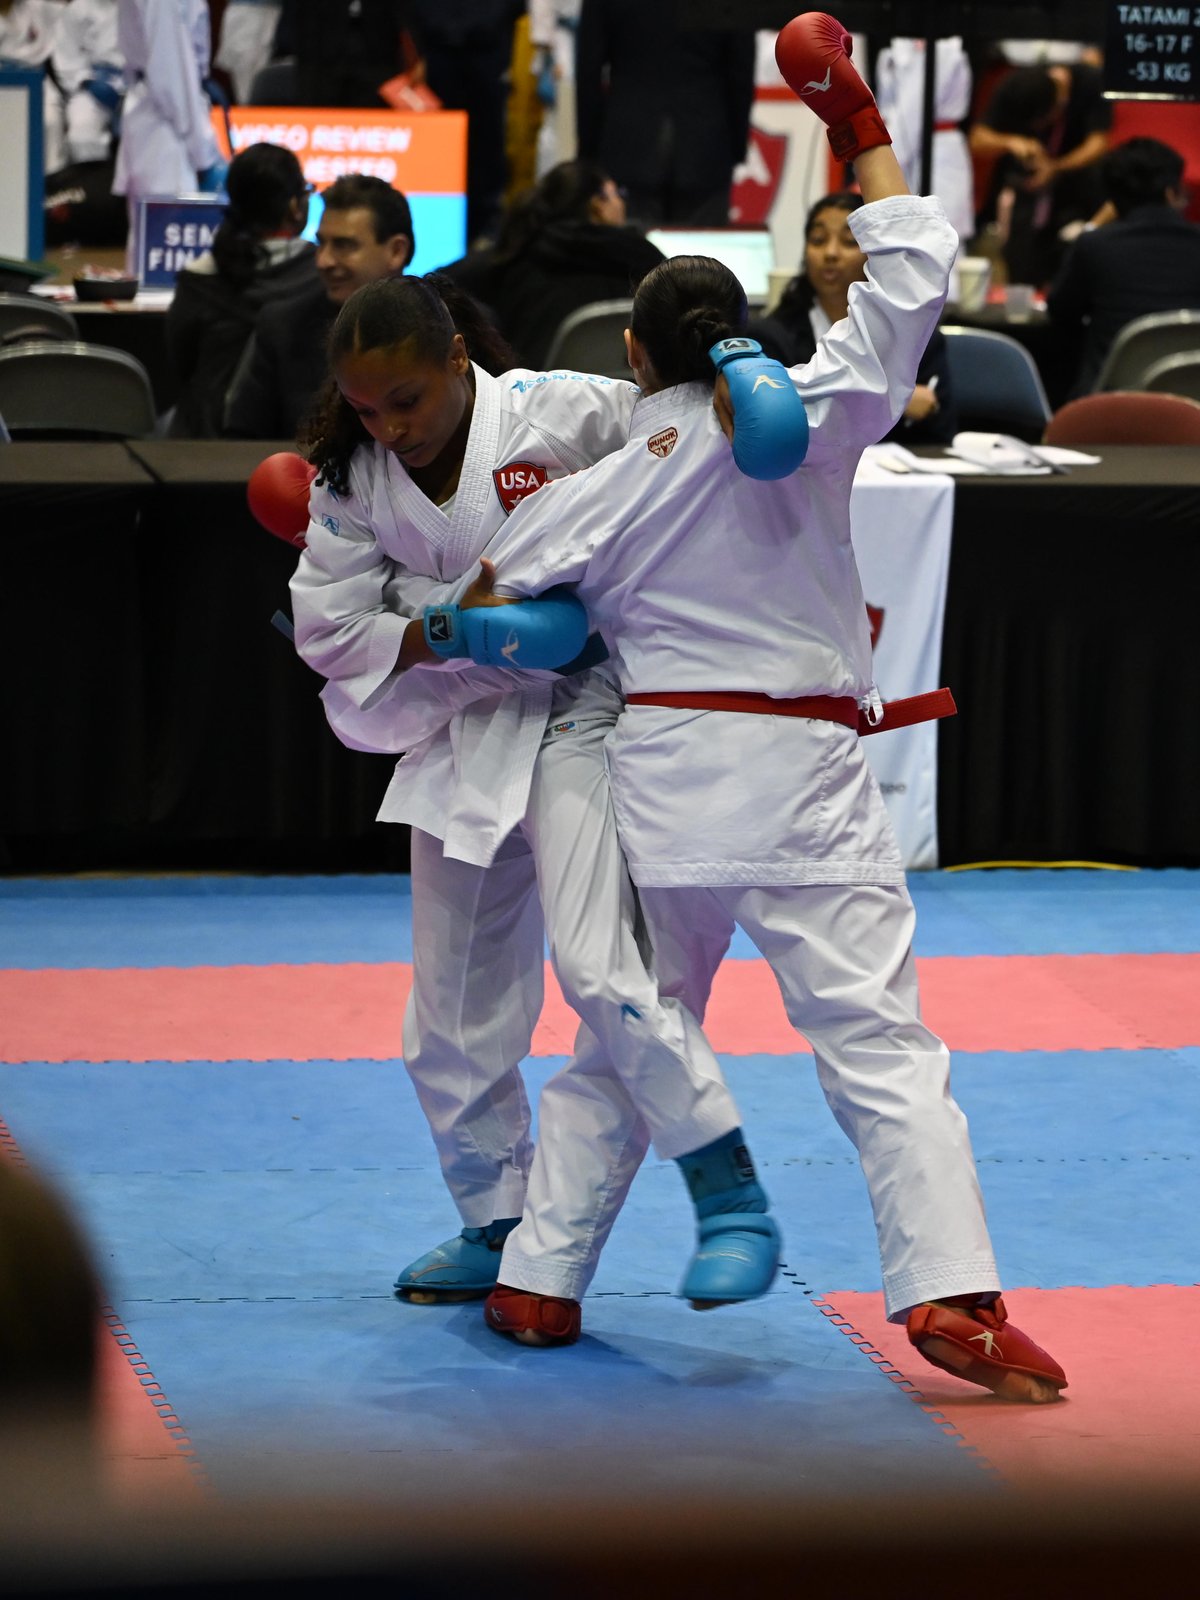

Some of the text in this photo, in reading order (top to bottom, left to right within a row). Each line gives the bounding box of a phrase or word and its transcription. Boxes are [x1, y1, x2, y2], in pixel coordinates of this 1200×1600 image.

[1117, 5, 1190, 26] TATAMI
[1125, 34, 1193, 53] 16-17 F
[1129, 62, 1191, 82] -53 KG
[311, 125, 411, 152] REVIEW
[165, 223, 220, 247] SEM
[500, 471, 541, 490] USA
